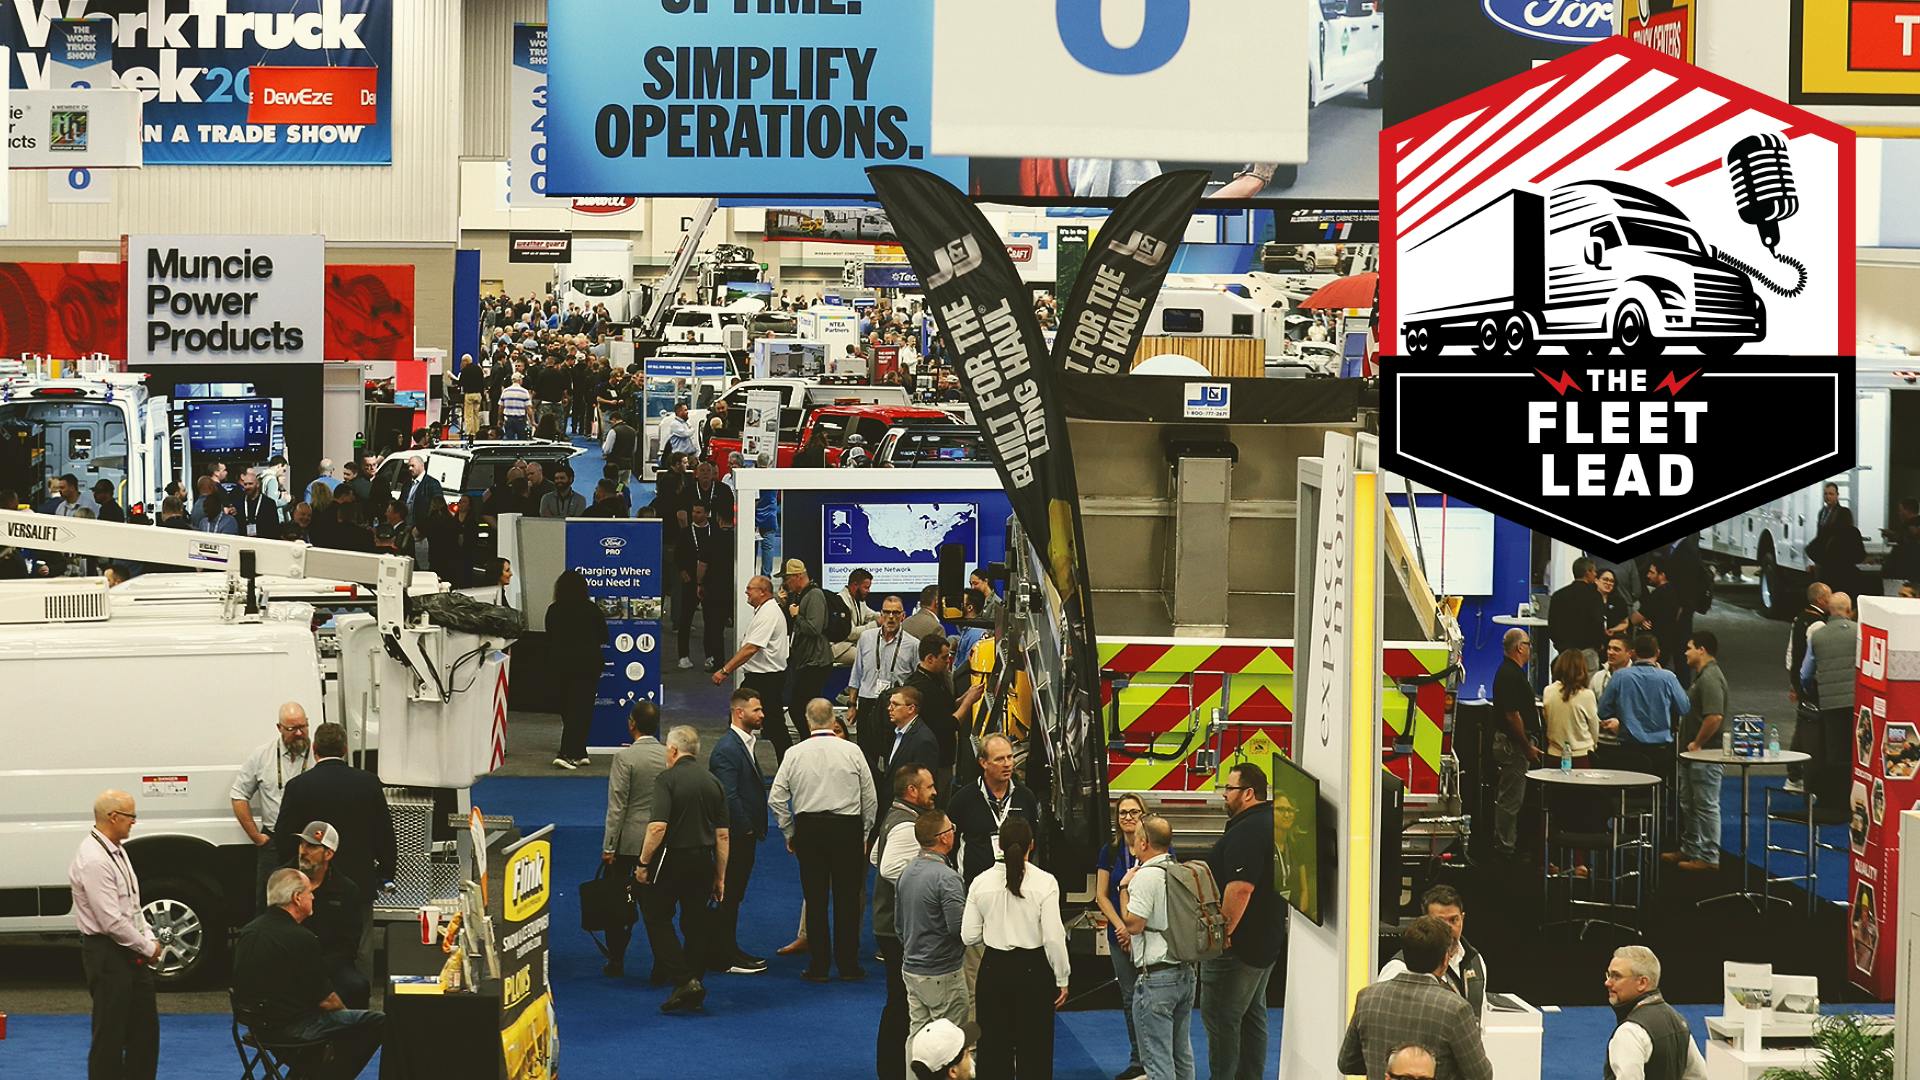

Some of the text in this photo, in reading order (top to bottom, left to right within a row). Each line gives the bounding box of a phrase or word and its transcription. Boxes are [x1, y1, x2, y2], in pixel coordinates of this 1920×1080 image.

[73, 26, 90, 34] THE
[536, 31, 547, 39] TH
[66, 43, 96, 51] TRUCK
[66, 52, 96, 60] SHOW
[643, 46, 877, 100] SIMPLIFY
[171, 125, 190, 143] A
[198, 125, 276, 143] TRADE
[287, 125, 361, 143] SHOW
[595, 104, 924, 160] OPERATIONS.
[148, 248, 273, 279] Muncie
[148, 284, 258, 315] Power
[1086, 263, 1126, 310] THE
[148, 320, 304, 352] Products
[1069, 309, 1108, 358] FOR
[941, 295, 1035, 489] BUILT FOR THE
[1013, 378, 1051, 459] LONG
[8, 522, 57, 541] VERSALIFT
[585, 578, 641, 588] You Need It
[620, 567, 651, 576] Where
[1320, 532, 1335, 748] expect
[513, 851, 544, 903] Flink
